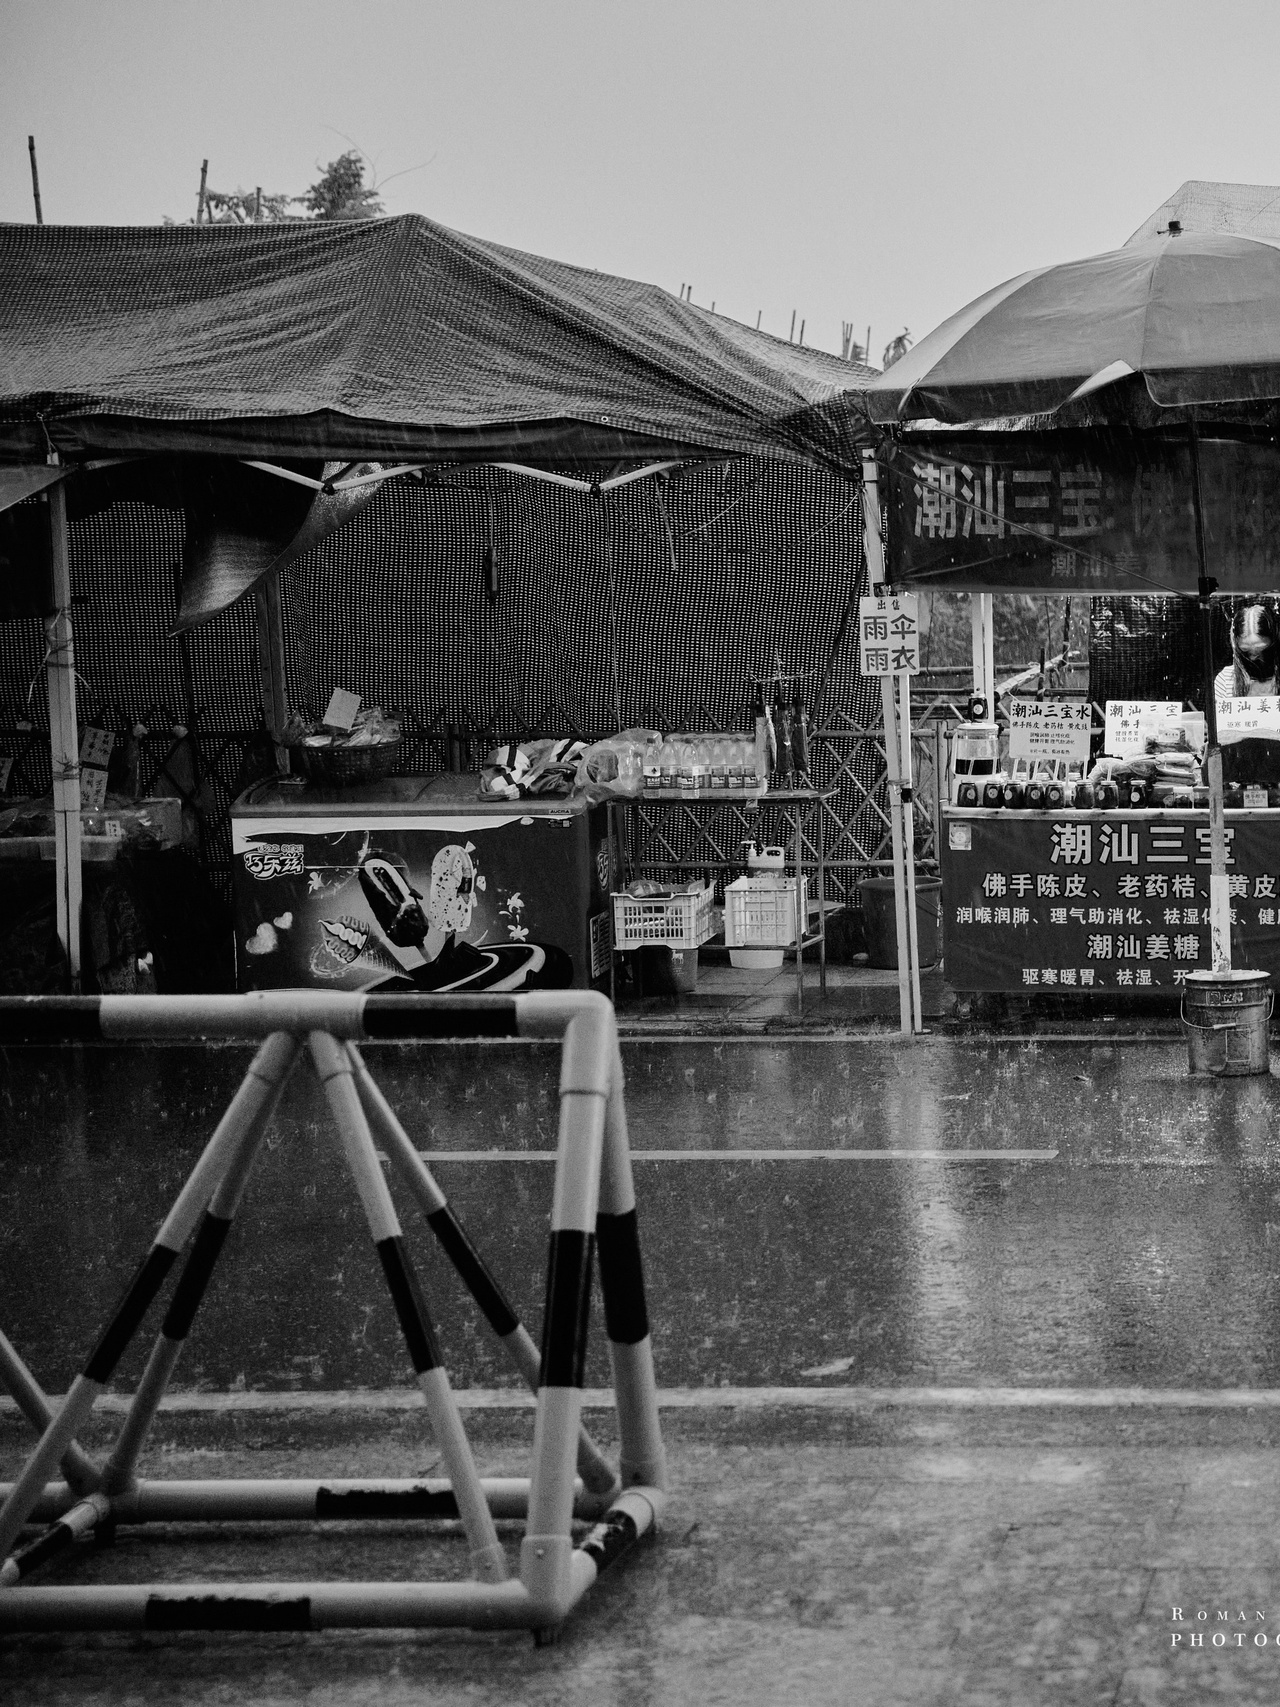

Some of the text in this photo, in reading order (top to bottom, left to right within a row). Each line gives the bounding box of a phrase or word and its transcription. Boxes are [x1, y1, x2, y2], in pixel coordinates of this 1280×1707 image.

[863, 613, 917, 641] 雨伞
[865, 645, 917, 672] 雨衣
[1012, 703, 1091, 720] 潮汕三宝水
[1050, 823, 1235, 865] 潮汕三宝
[244, 850, 304, 880] 巧乐兹
[1087, 934, 1201, 960] 潮汕姜糖
[1022, 968, 1208, 986] 驱寒暖胃、祛湿、开
